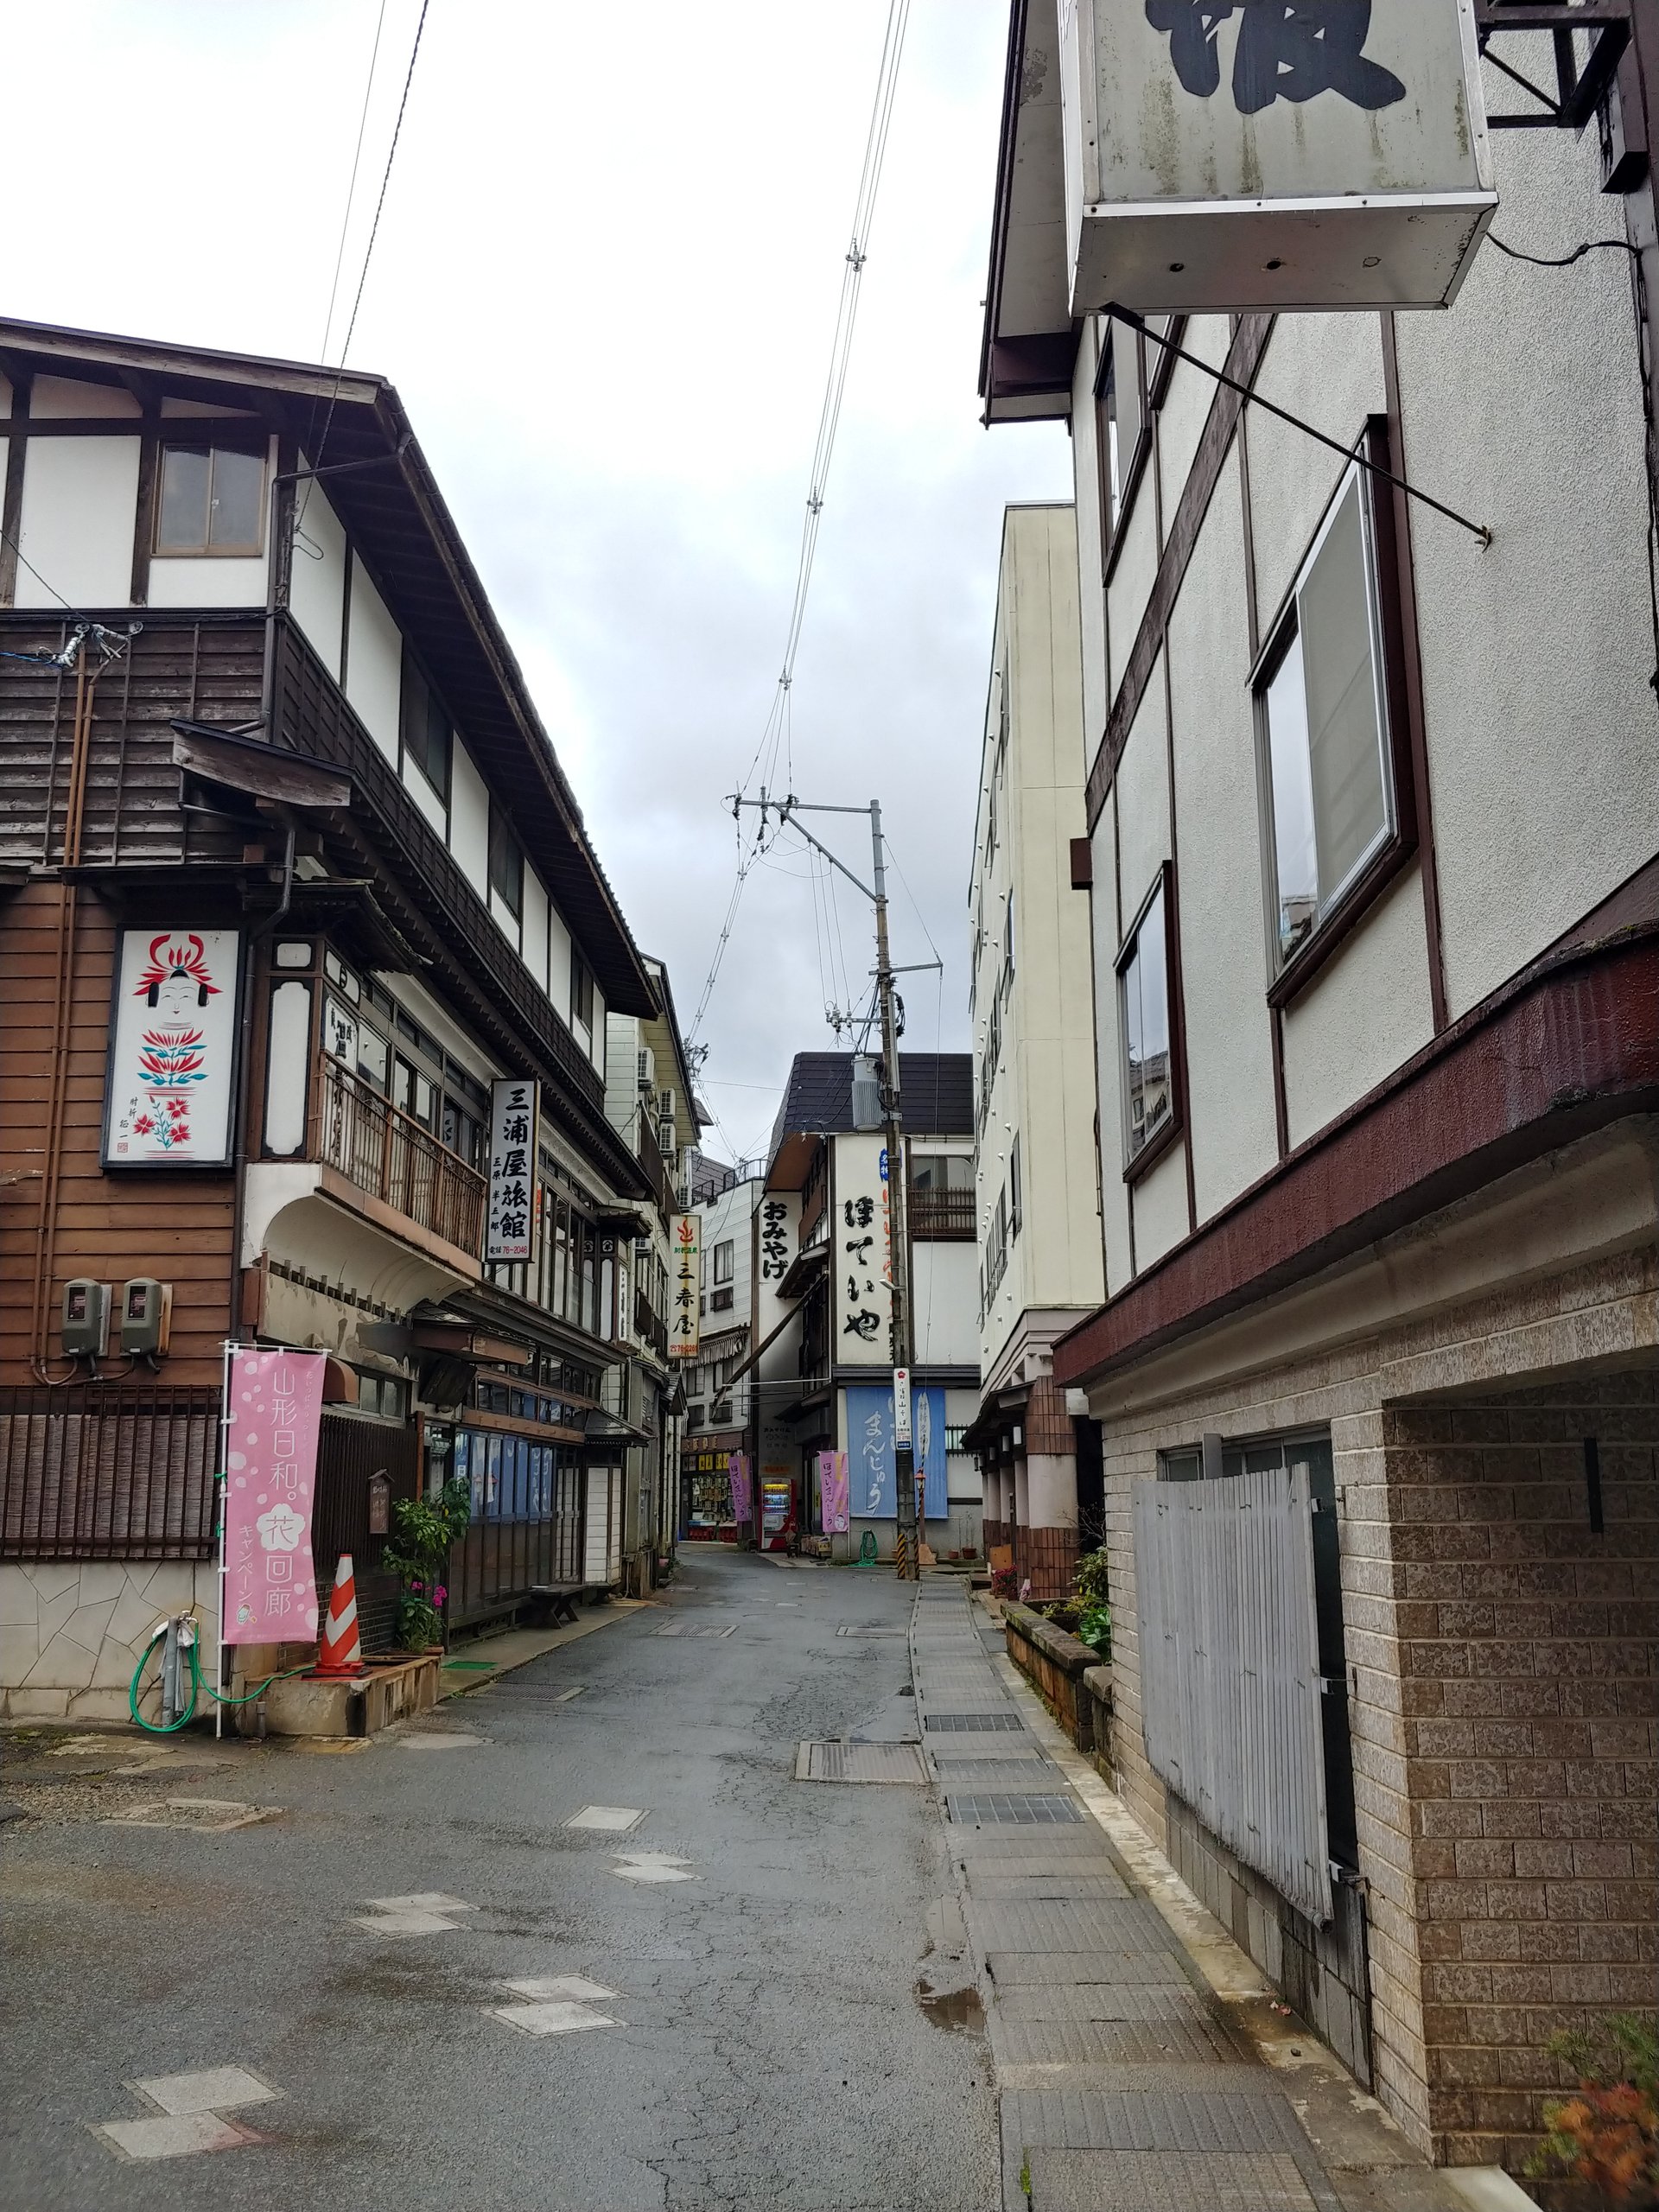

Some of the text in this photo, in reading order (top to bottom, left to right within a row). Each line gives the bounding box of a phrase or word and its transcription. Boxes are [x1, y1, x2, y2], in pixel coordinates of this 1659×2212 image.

[499, 1087, 530, 1239] 三浦屋旅館
[502, 1245, 528, 1255] 76-2046
[762, 1201, 790, 1280] おみやげ
[843, 1195, 880, 1343] ほていや
[673, 1262, 696, 1335] 三春屋
[862, 1410, 887, 1516] まんじゅう
[236, 1524, 253, 1604] キャンペーン
